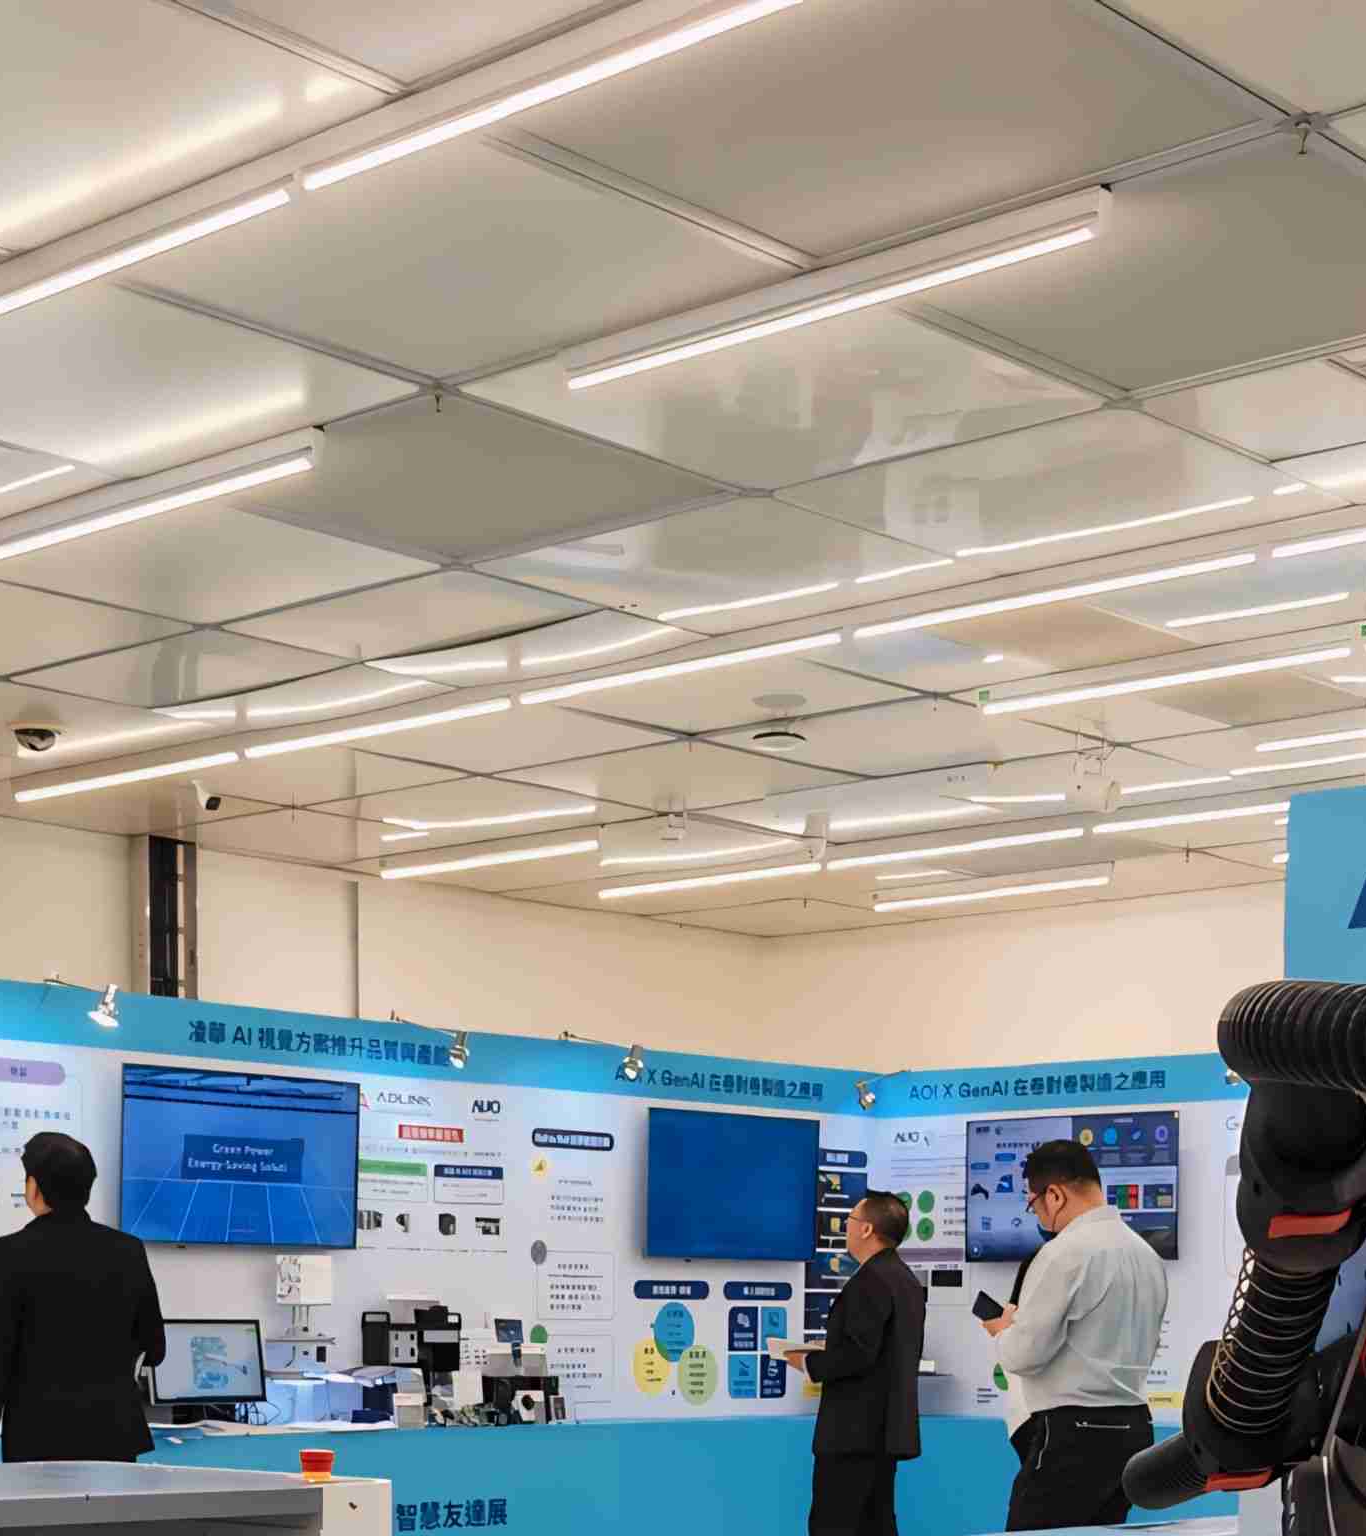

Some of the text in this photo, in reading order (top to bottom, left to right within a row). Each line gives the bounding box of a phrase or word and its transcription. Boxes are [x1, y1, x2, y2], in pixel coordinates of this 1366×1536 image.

[232, 1027, 252, 1046] AI
[661, 1070, 705, 1089] GenAI
[910, 1085, 937, 1100] AOI
[943, 1084, 953, 1097] X
[958, 1080, 1008, 1098] GenAI
[472, 1100, 501, 1114] AUO
[396, 1498, 507, 1532] 智慧友達展
